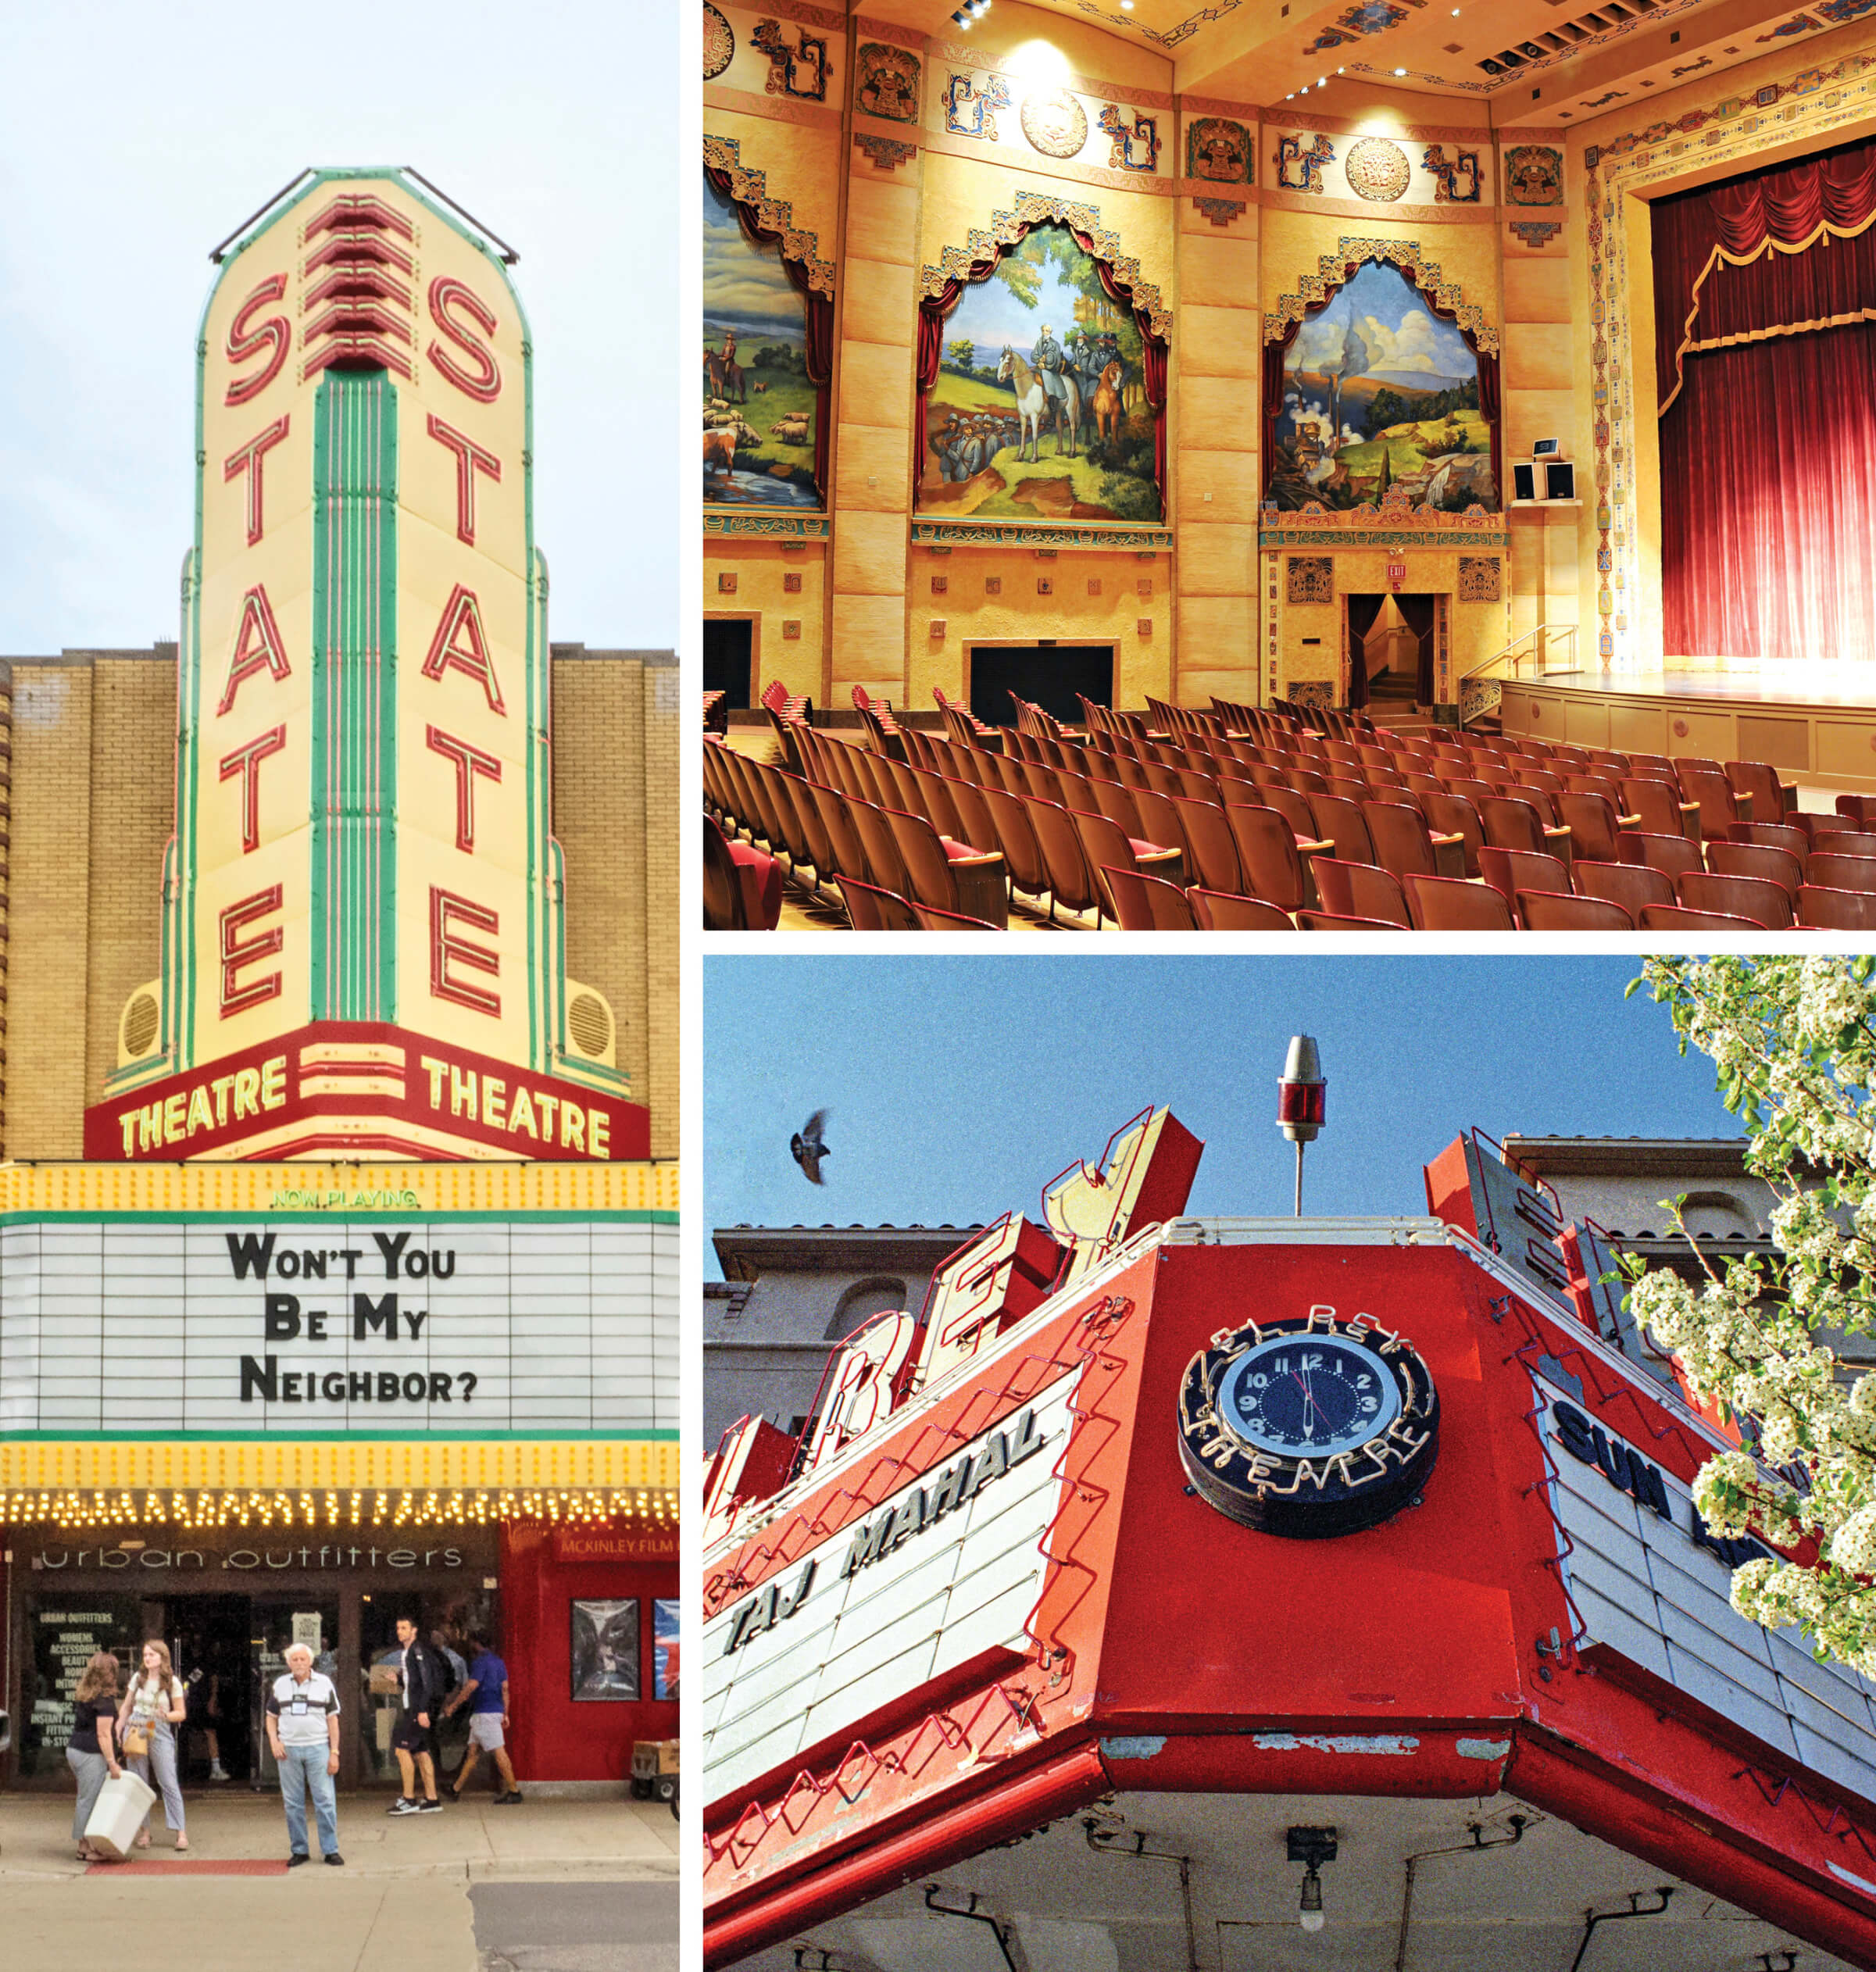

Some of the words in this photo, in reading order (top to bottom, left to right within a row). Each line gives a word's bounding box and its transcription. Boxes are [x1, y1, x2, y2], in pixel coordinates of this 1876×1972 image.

[1389, 566, 1405, 577] EXIT
[216, 272, 291, 1020] STATE
[422, 273, 507, 1020] STATE
[119, 1055, 287, 1158] THEATRE
[420, 1055, 610, 1159] THEATRE
[273, 1189, 317, 1208] NOW
[327, 1189, 418, 1208] PLAYING
[1274, 1358, 1288, 1373] 11
[1336, 1359, 1343, 1374] 1
[1246, 1373, 1268, 1389] 10
[1356, 1374, 1372, 1389] 2
[1238, 1395, 1258, 1412] 9
[1360, 1395, 1378, 1413] 3
[1247, 1418, 1266, 1434] 8
[723, 1559, 817, 1656] TAJ
[841, 1409, 1045, 1579] MAHAL
[561, 1539, 635, 1553] MCKINLEY
[639, 1539, 674, 1553] FILM
[42, 1547, 203, 1568] urban
[229, 1545, 462, 1568] outfitters
[68, 1613, 113, 1624] OUTFITTERS
